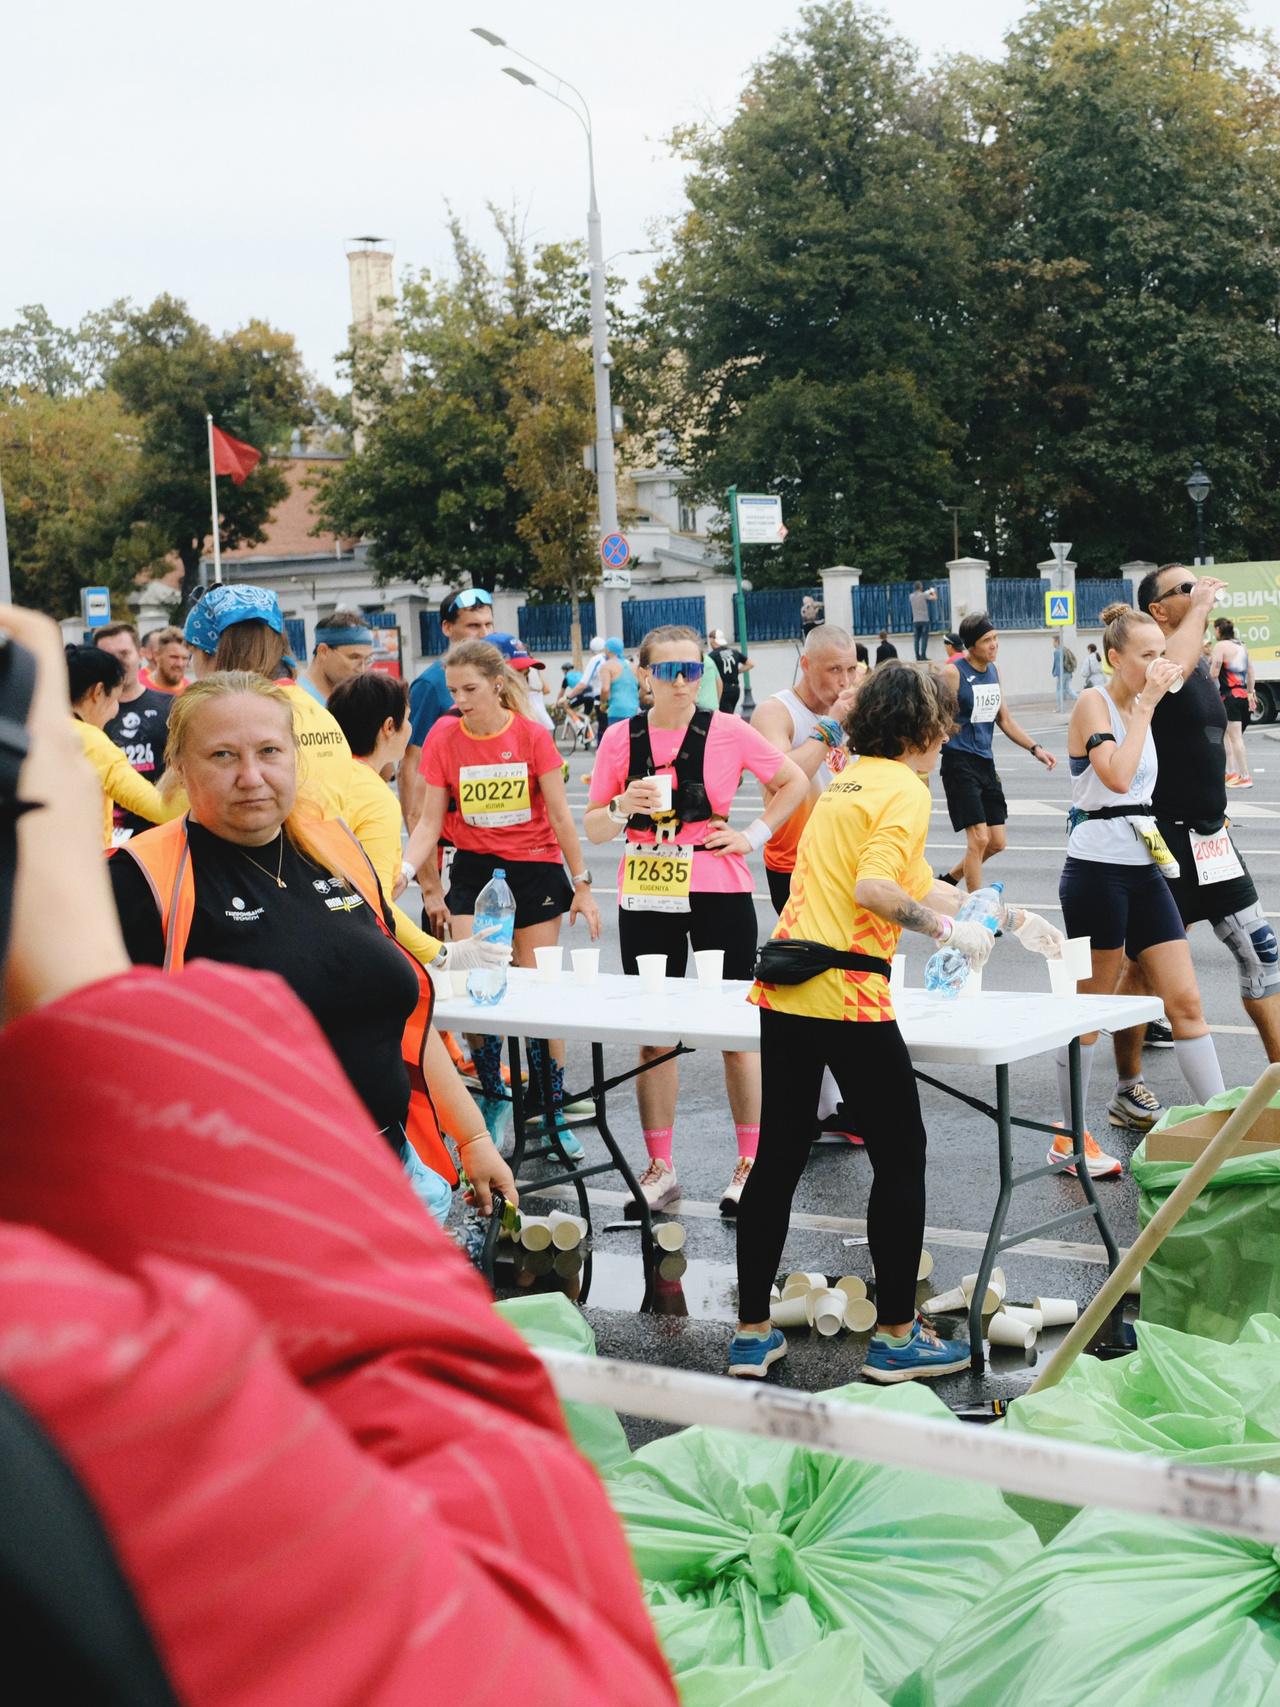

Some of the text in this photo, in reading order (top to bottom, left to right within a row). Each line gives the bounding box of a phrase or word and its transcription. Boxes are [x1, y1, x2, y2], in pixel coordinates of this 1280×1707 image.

[976, 693, 1000, 707] 11659
[462, 780, 526, 802] 20227
[1194, 837, 1230, 861] 20867
[628, 859, 689, 883] 12635
[640, 884, 670, 892] EUGENIYA
